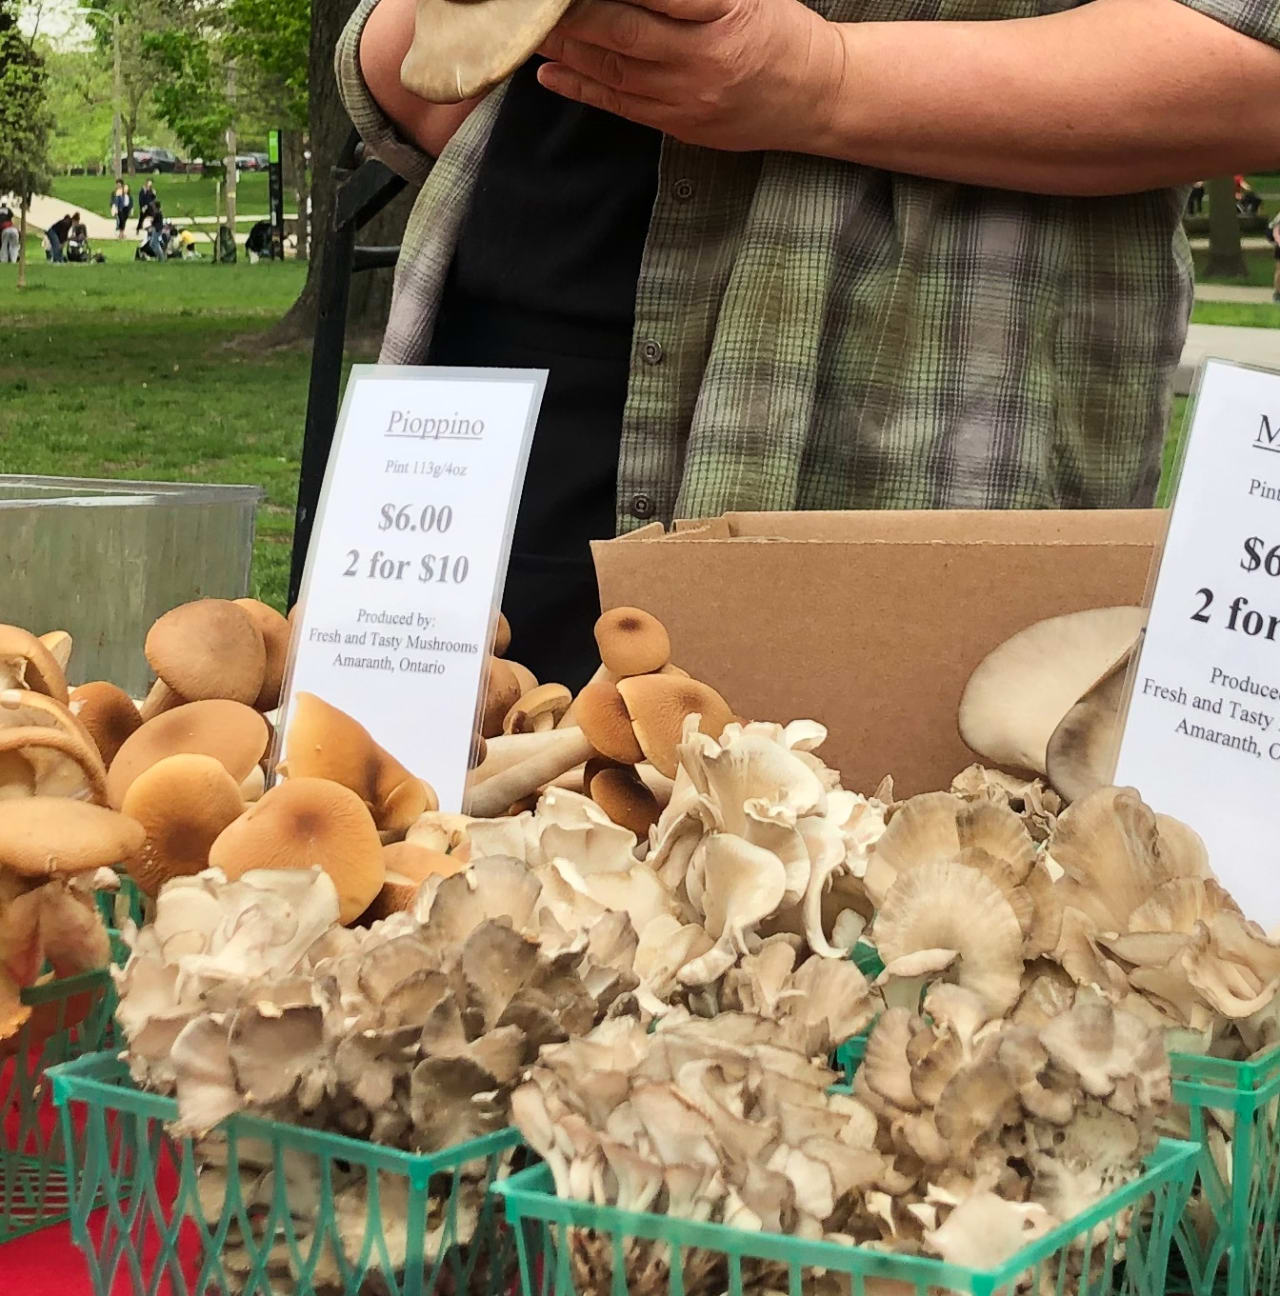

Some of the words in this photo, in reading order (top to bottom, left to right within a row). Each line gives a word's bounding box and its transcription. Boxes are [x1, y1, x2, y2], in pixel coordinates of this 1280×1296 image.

[386, 410, 484, 440] Pioppino
[384, 459, 409, 475] Pint
[413, 460, 468, 478] 113g/4oz
[377, 503, 453, 533] $6.00
[342, 549, 360, 577] 2
[368, 551, 410, 581] for
[419, 553, 469, 584] $10
[357, 608, 413, 626] Produced
[417, 611, 436, 629] by:
[1190, 587, 1215, 624] 2
[308, 628, 341, 645] Fresh
[344, 630, 366, 646] and
[370, 632, 403, 650] Tasty
[406, 634, 479, 654] Mushrooms
[333, 653, 395, 673] Amaranth,
[399, 657, 446, 675] Ontario
[1142, 678, 1187, 706] Fresh
[1192, 693, 1222, 715] and
[1228, 700, 1274, 731] Tasty
[1175, 719, 1262, 759] Amaranth,
